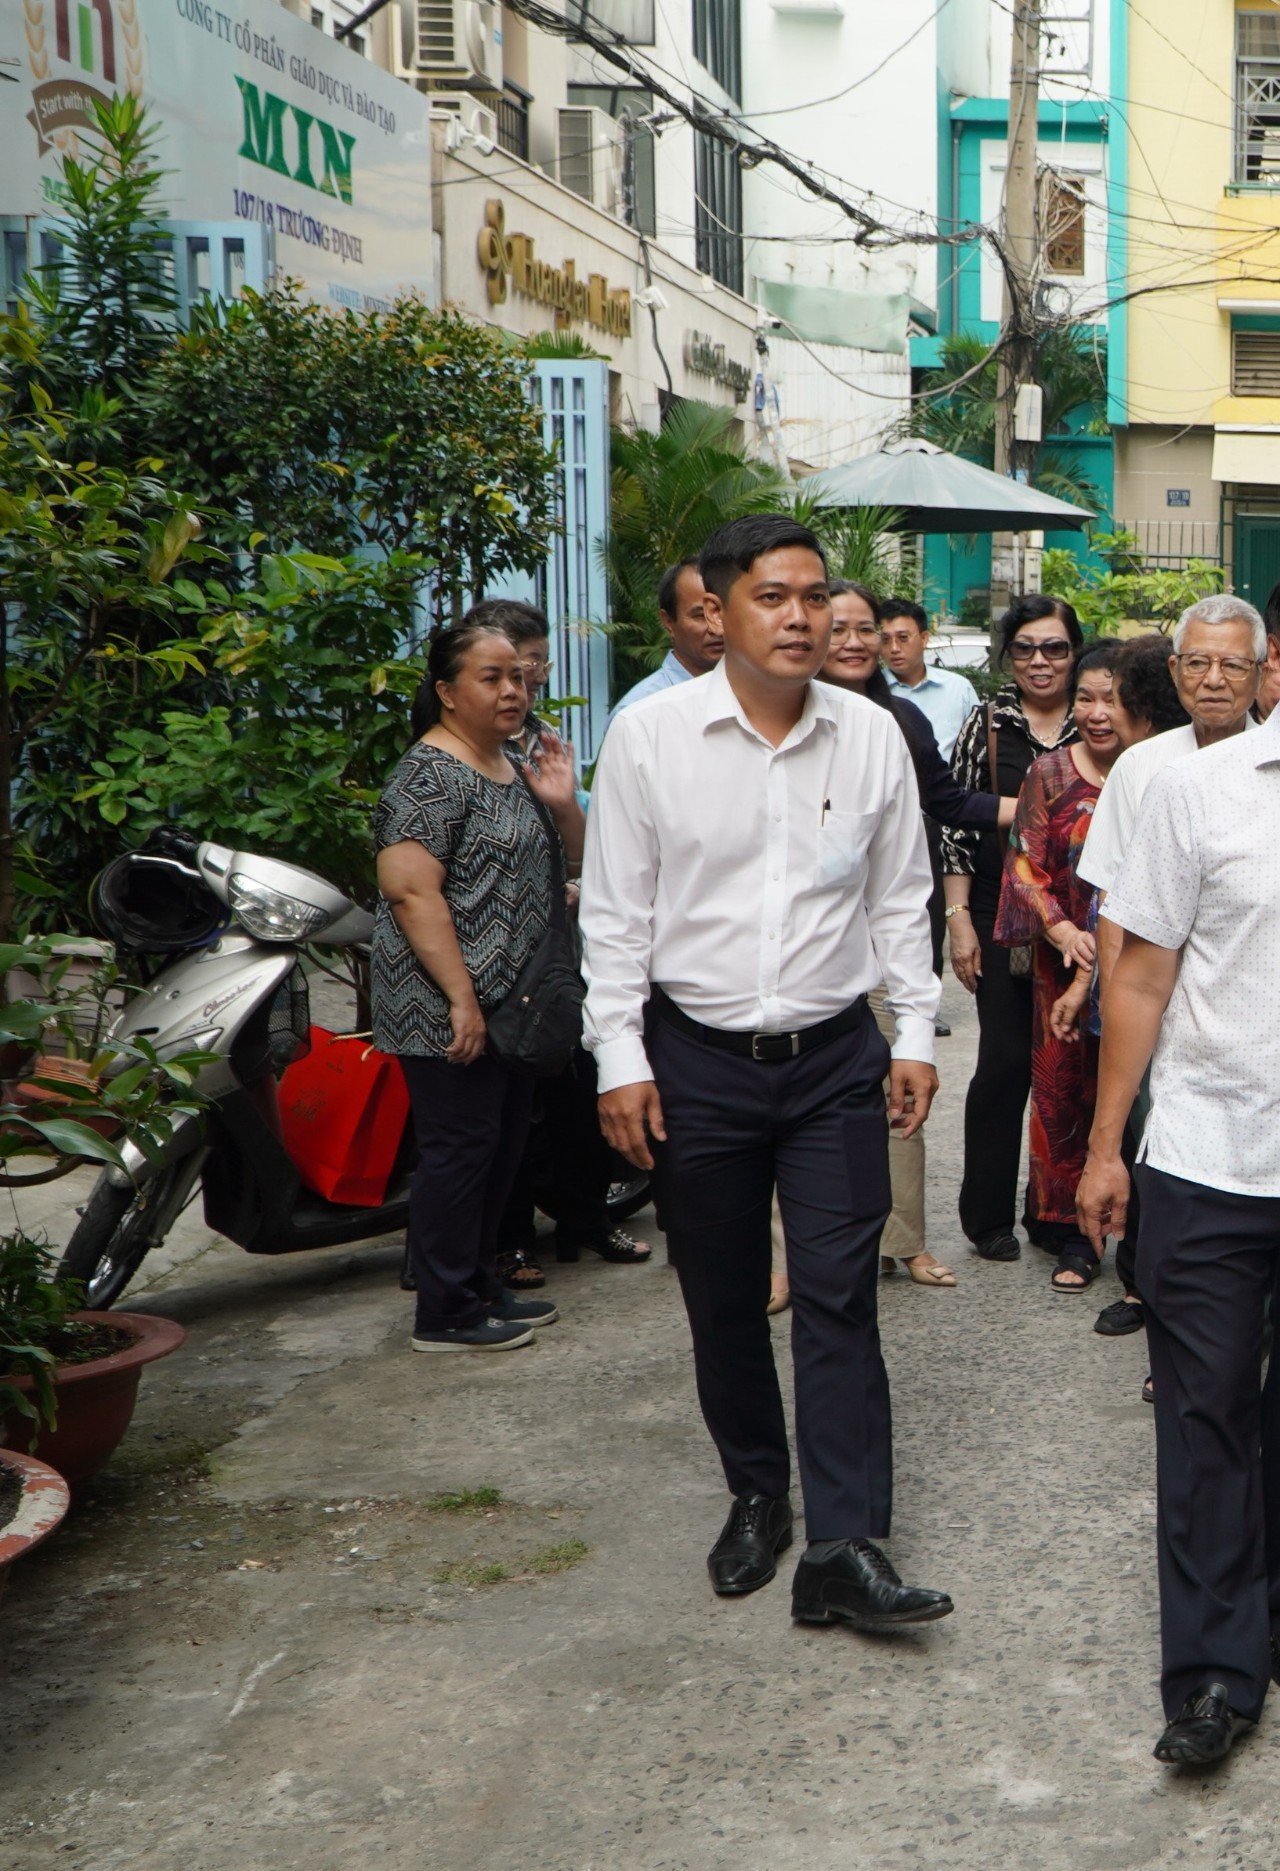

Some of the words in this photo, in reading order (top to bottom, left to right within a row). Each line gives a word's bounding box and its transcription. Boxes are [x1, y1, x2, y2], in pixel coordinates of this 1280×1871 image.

[215, 10, 232, 43] TY
[318, 71, 341, 106] DỤC
[233, 73, 357, 206] MIN
[233, 188, 275, 227] 107/18
[332, 226, 364, 264] ĐỊNH
